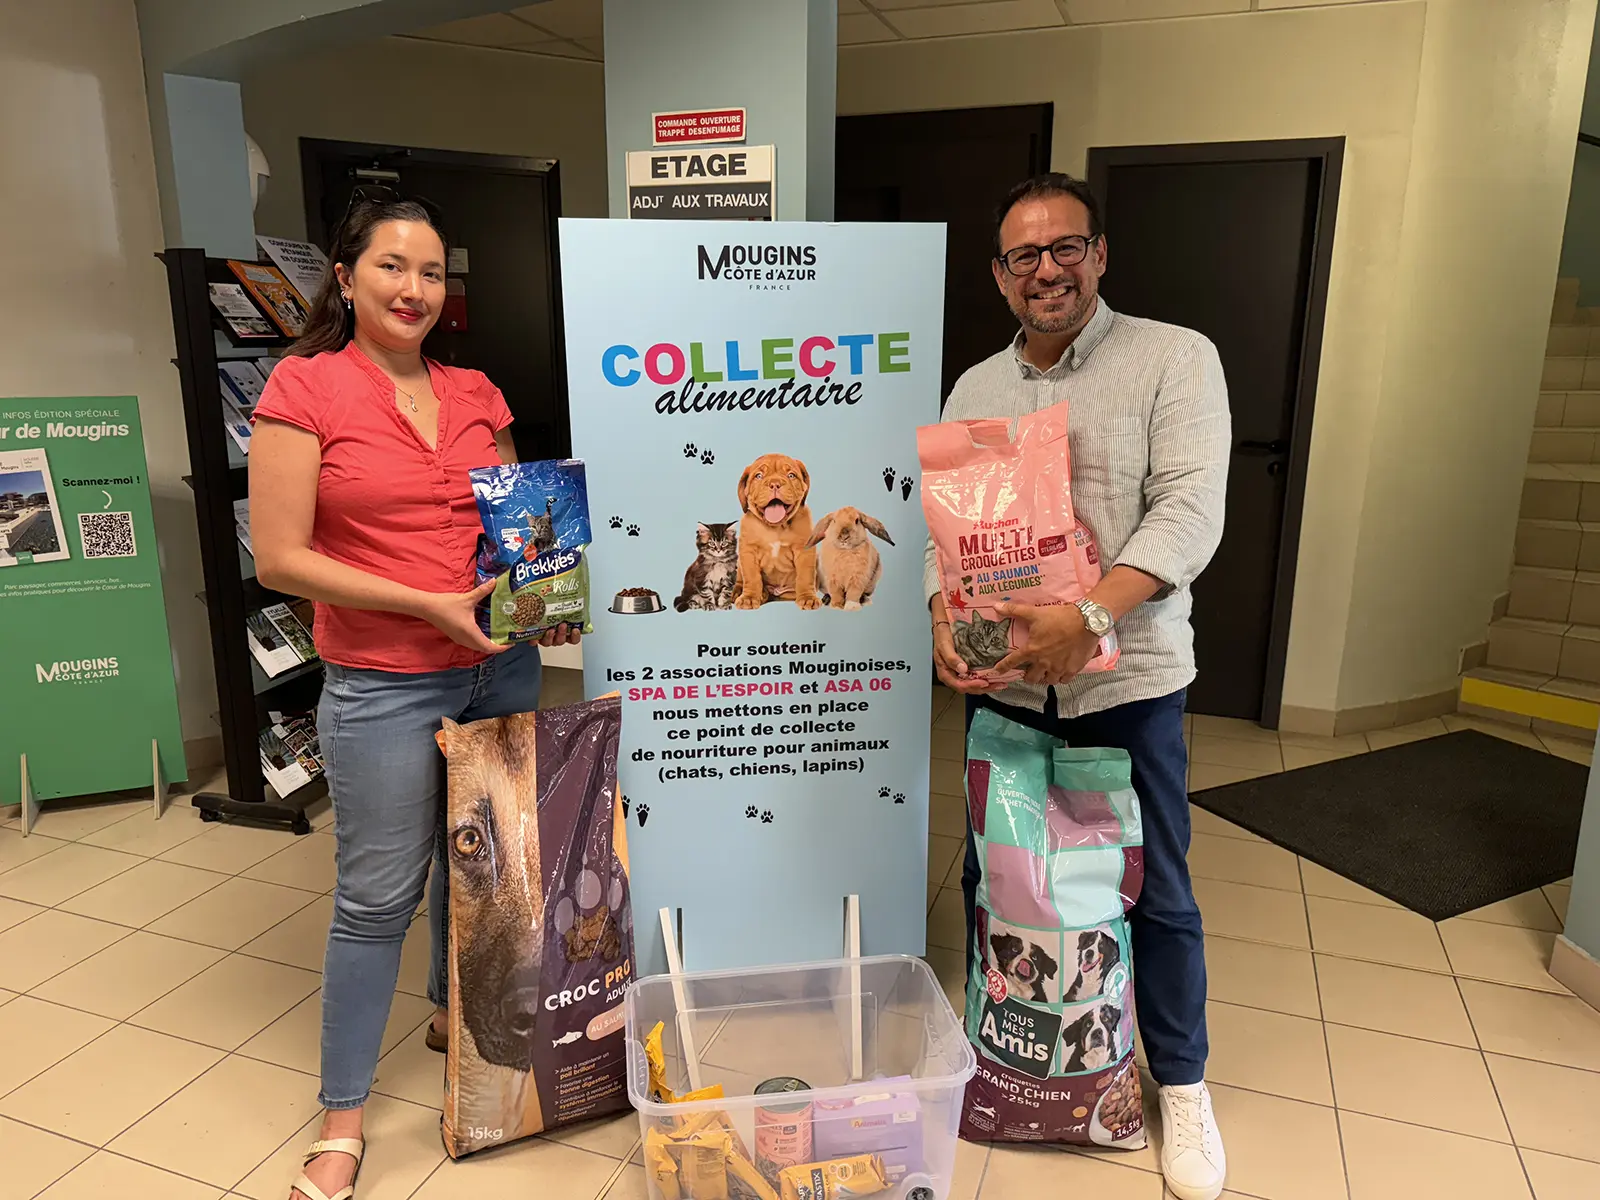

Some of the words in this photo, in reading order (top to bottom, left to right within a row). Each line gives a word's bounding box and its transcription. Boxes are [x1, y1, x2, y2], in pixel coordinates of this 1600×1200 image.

[658, 117, 697, 128] COMMANDE
[700, 115, 741, 125] OUVERTURE
[658, 128, 685, 138] TRAPPE
[688, 125, 741, 136] DESENFUMAGE
[651, 153, 747, 179] ETAGE
[672, 195, 701, 208] AUX
[705, 193, 768, 207] TRAVAUX
[697, 245, 817, 280] MOUGINS
[724, 266, 761, 281] CÔTE
[601, 332, 911, 387] COLLECTE
[655, 376, 863, 415] alimentaire
[3, 411, 31, 419] INFOS
[34, 410, 72, 419] ÉDITION
[75, 409, 120, 418] SPÉCIALE
[15, 423, 41, 438] de
[46, 421, 129, 441] Mougins
[62, 476, 133, 487] Scannez-moi
[136, 476, 140, 484] !
[973, 518, 1019, 530] Auchan
[516, 552, 575, 582] Brekkies
[961, 546, 1036, 571] CROQUETTES
[553, 578, 580, 594] Rolls
[977, 572, 990, 583] AU
[979, 584, 997, 596] AUX
[697, 644, 741, 657] Pour
[747, 640, 826, 655] soutenir
[35, 657, 119, 683] MOUGINS
[55, 671, 82, 682] CÔTE
[607, 668, 636, 681] les
[642, 667, 653, 680] 2
[660, 663, 782, 679] associations
[789, 658, 911, 676] Mouginoises,
[628, 687, 666, 701] SPA
[673, 685, 699, 699] DE
[800, 681, 819, 694] et
[824, 679, 863, 693] ASA
[869, 677, 892, 691] 06
[653, 708, 699, 720] nous
[705, 704, 783, 718] mettons
[789, 704, 812, 714] en
[818, 700, 869, 716] place
[667, 729, 691, 740] ce
[697, 724, 745, 741] point
[751, 723, 774, 736] de
[780, 719, 856, 735] collecte
[631, 748, 655, 761] de
[661, 744, 757, 760] nourriture
[763, 743, 805, 758] pour
[811, 738, 889, 753] animaux
[658, 766, 723, 784] (chats,
[729, 762, 796, 776] chiens,
[803, 757, 865, 774] lapins)
[545, 978, 600, 1011] CROC
[605, 959, 630, 989] PRO
[1003, 1007, 1034, 1028] TOUS
[591, 1024, 602, 1033] AU
[981, 1011, 1049, 1062] Amis
[1001, 1020, 1025, 1037] MES
[560, 1070, 573, 1081] poil
[976, 1064, 1020, 1094] GRAND
[1024, 1087, 1071, 1101] CHIEN
[1000, 1072, 1040, 1089] croquettes
[467, 1126, 503, 1140] 15kg
